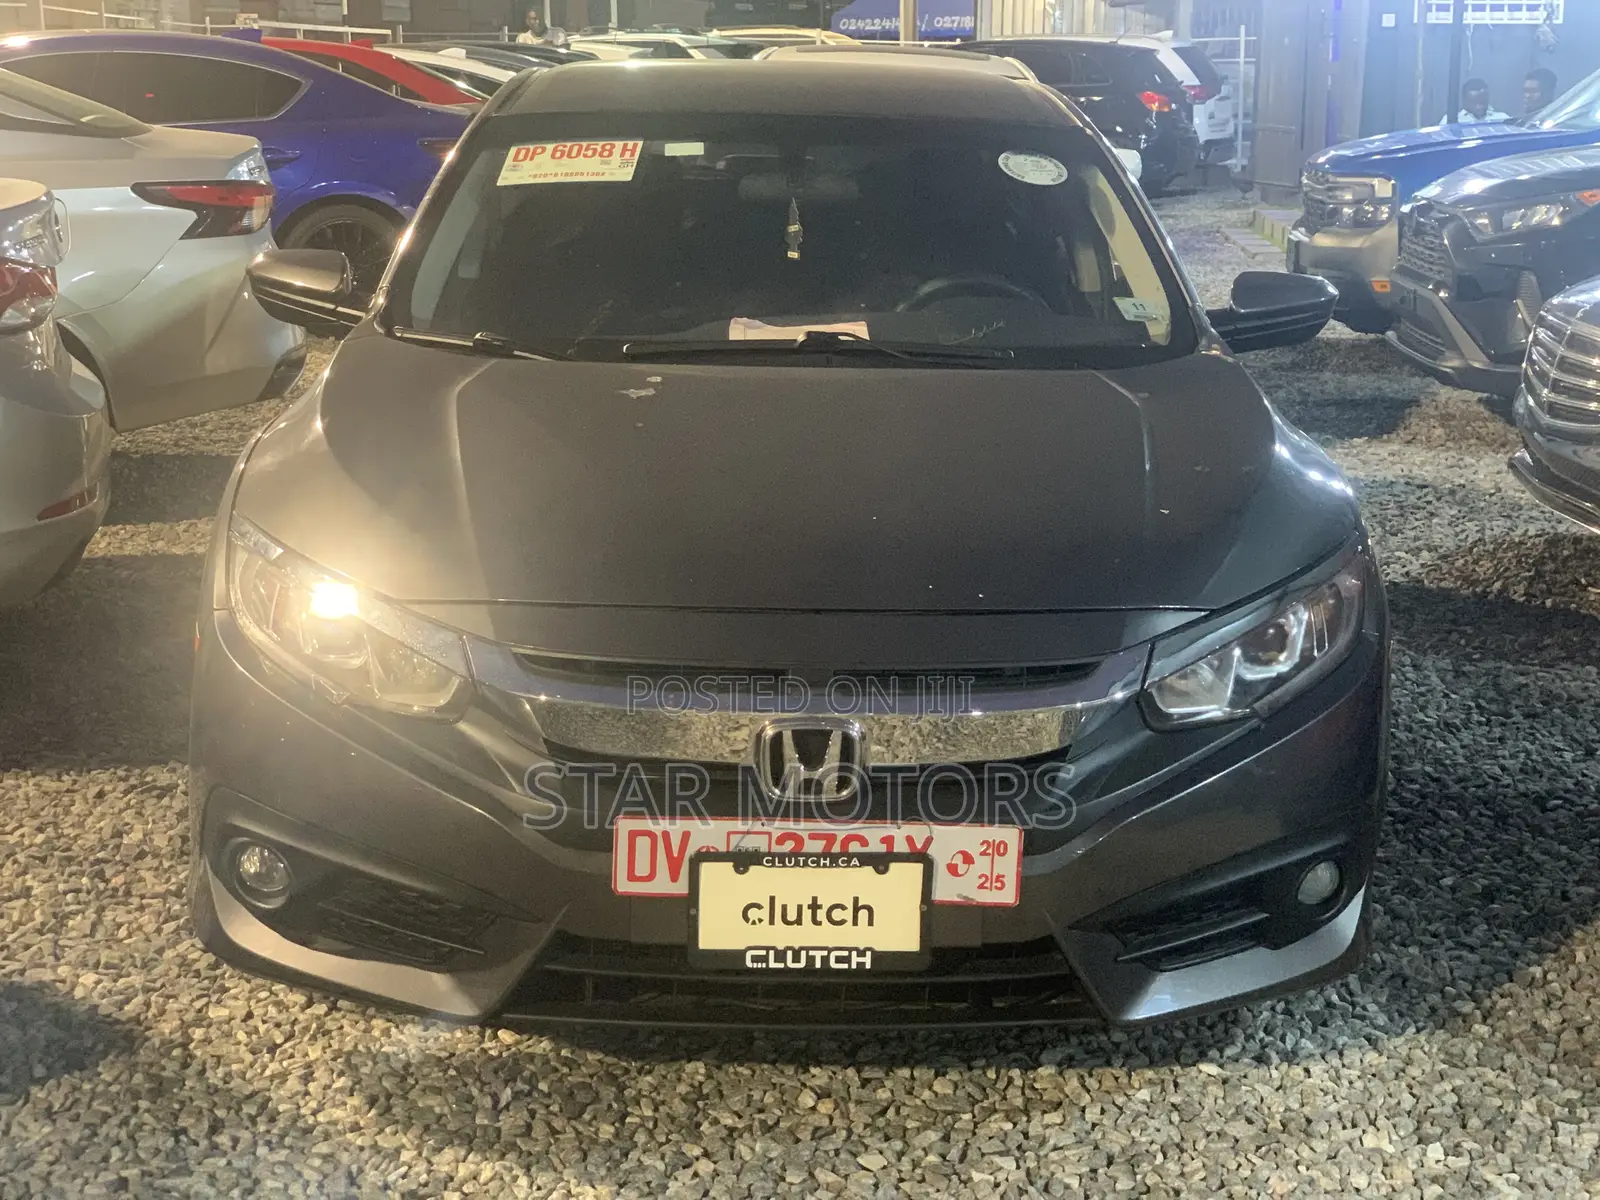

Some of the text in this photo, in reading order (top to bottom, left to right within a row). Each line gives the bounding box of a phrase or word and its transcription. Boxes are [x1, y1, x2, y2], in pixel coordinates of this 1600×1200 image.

[512, 142, 639, 162] DP 6058 H
[627, 829, 691, 883] DV
[762, 856, 861, 867] CLUTCH.CA
[741, 895, 875, 927] clutch
[745, 949, 872, 970] CLUTCH
